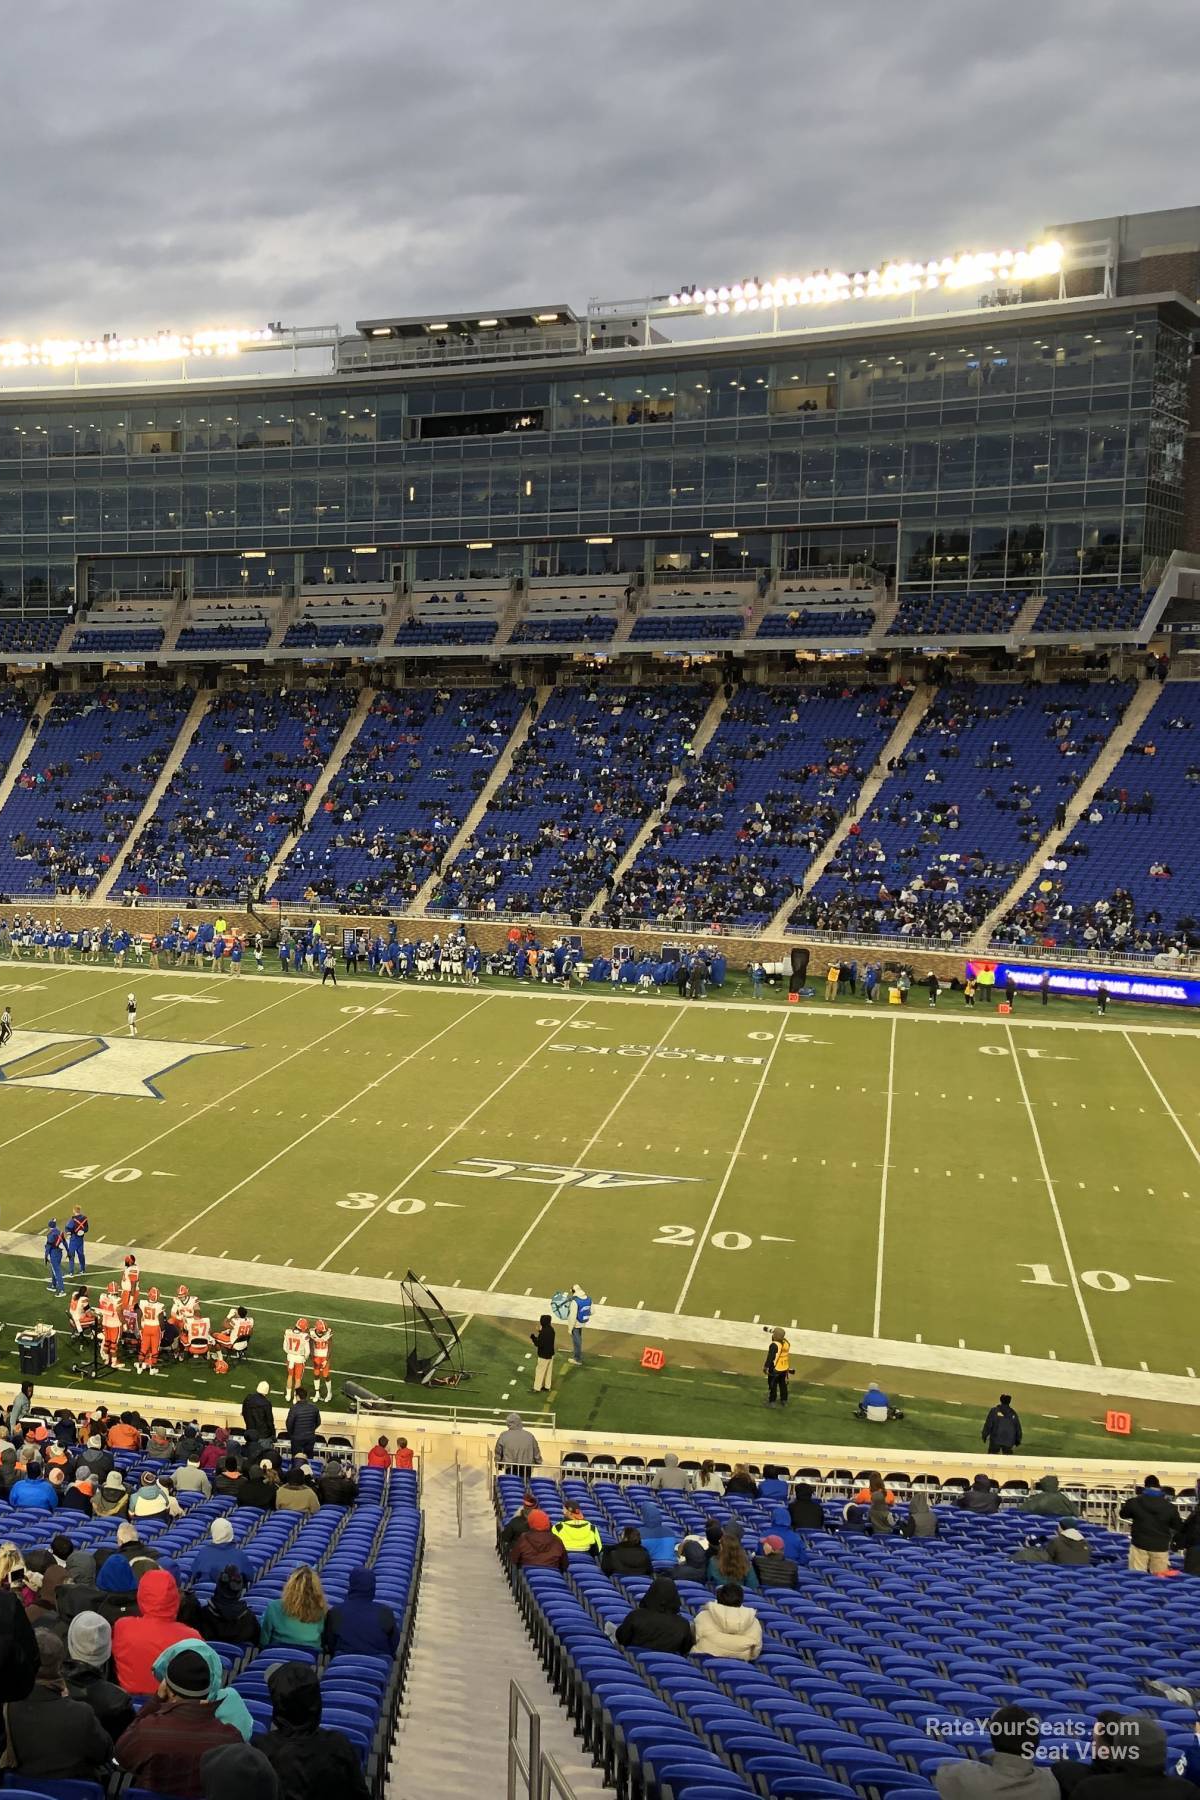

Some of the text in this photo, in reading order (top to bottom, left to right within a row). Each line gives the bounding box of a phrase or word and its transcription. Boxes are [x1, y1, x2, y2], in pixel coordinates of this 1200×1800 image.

[747, 1031, 814, 1043] 20
[547, 1044, 765, 1065] BROOKS
[57, 1164, 143, 1183] 40
[432, 1157, 706, 1189] ACC
[335, 1192, 427, 1215] 30
[652, 1225, 754, 1250] 20
[1015, 1263, 1131, 1293] 10
[144, 1307, 157, 1321] 51
[191, 1323, 207, 1336] 57
[287, 1337, 301, 1352] 17
[643, 1350, 661, 1367] 20
[1110, 1412, 1128, 1433] 10
